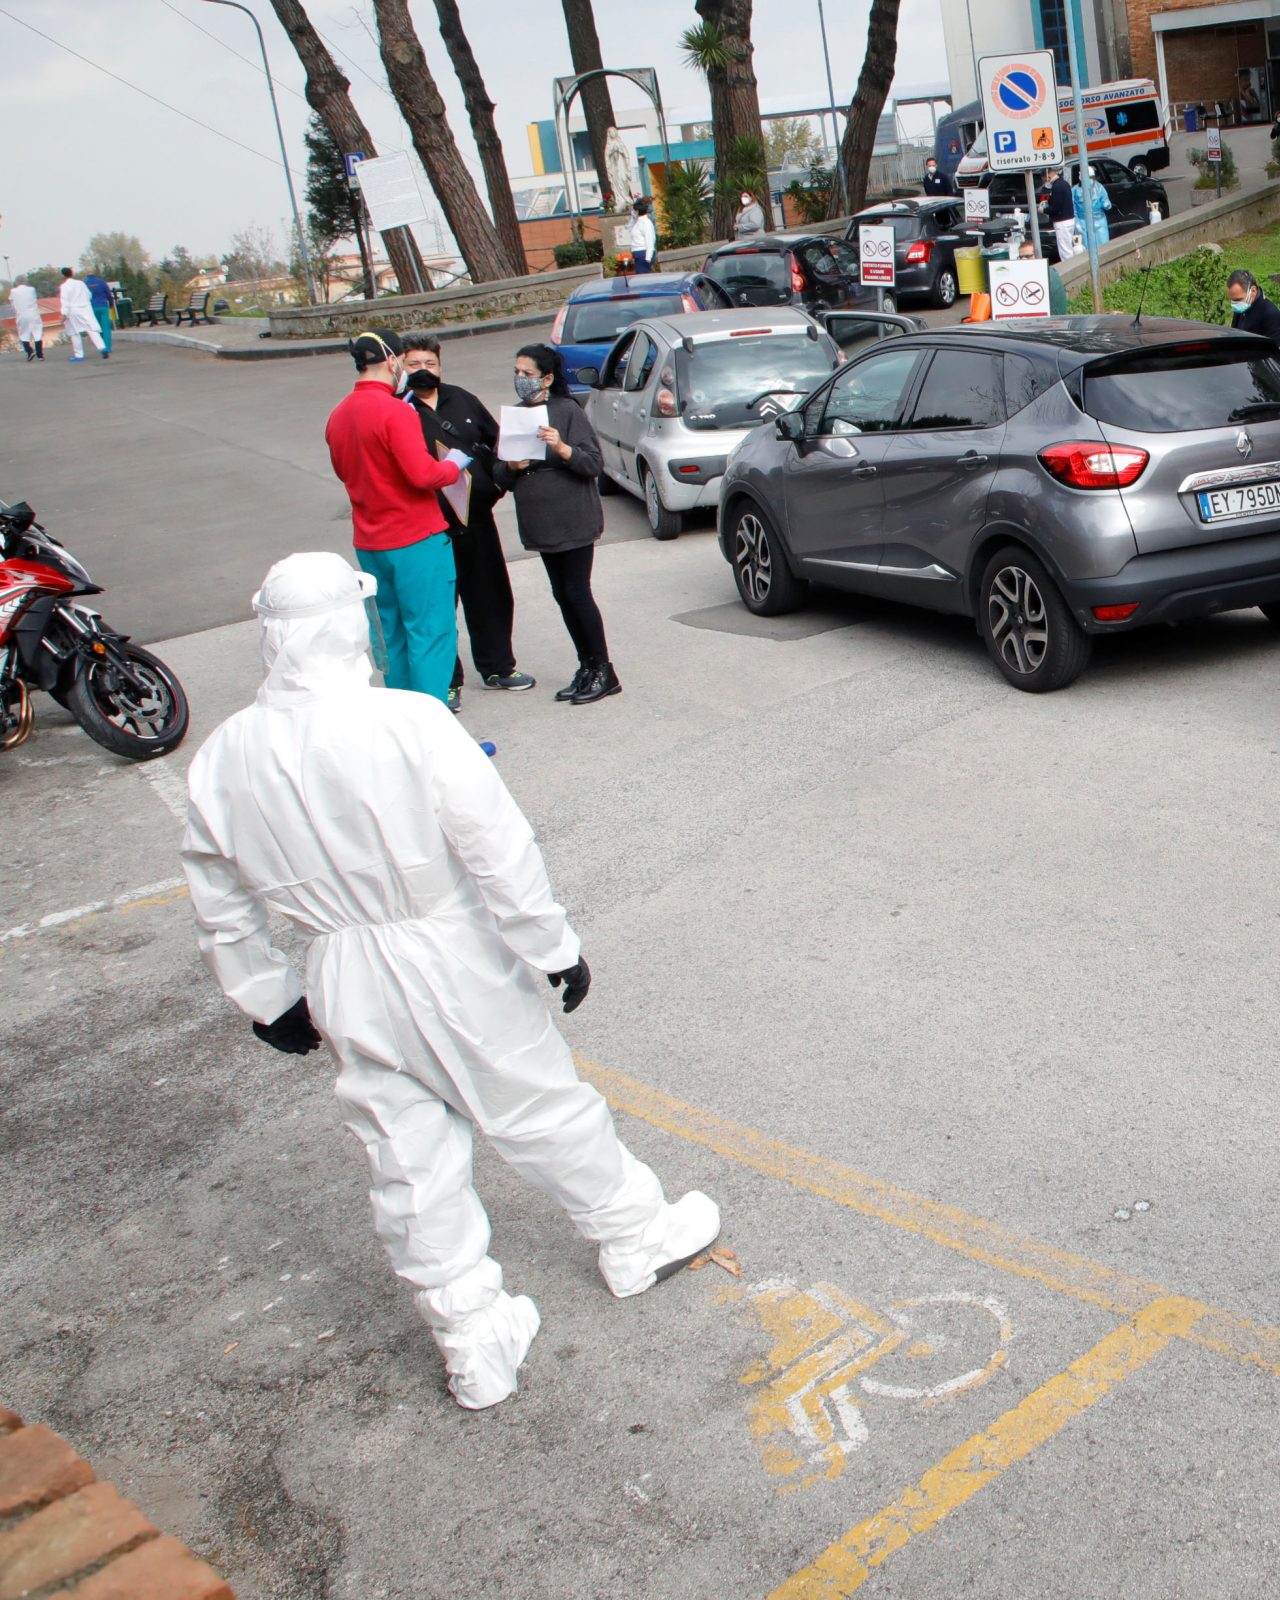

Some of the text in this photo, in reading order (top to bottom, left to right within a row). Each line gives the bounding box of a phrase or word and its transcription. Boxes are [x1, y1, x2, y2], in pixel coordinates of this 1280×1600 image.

[1059, 88, 1145, 108] SOCORSO AVANZATO
[998, 133, 1012, 150] P
[996, 152, 1056, 165] riservato 7-8-9
[1210, 492, 1230, 514] EY
